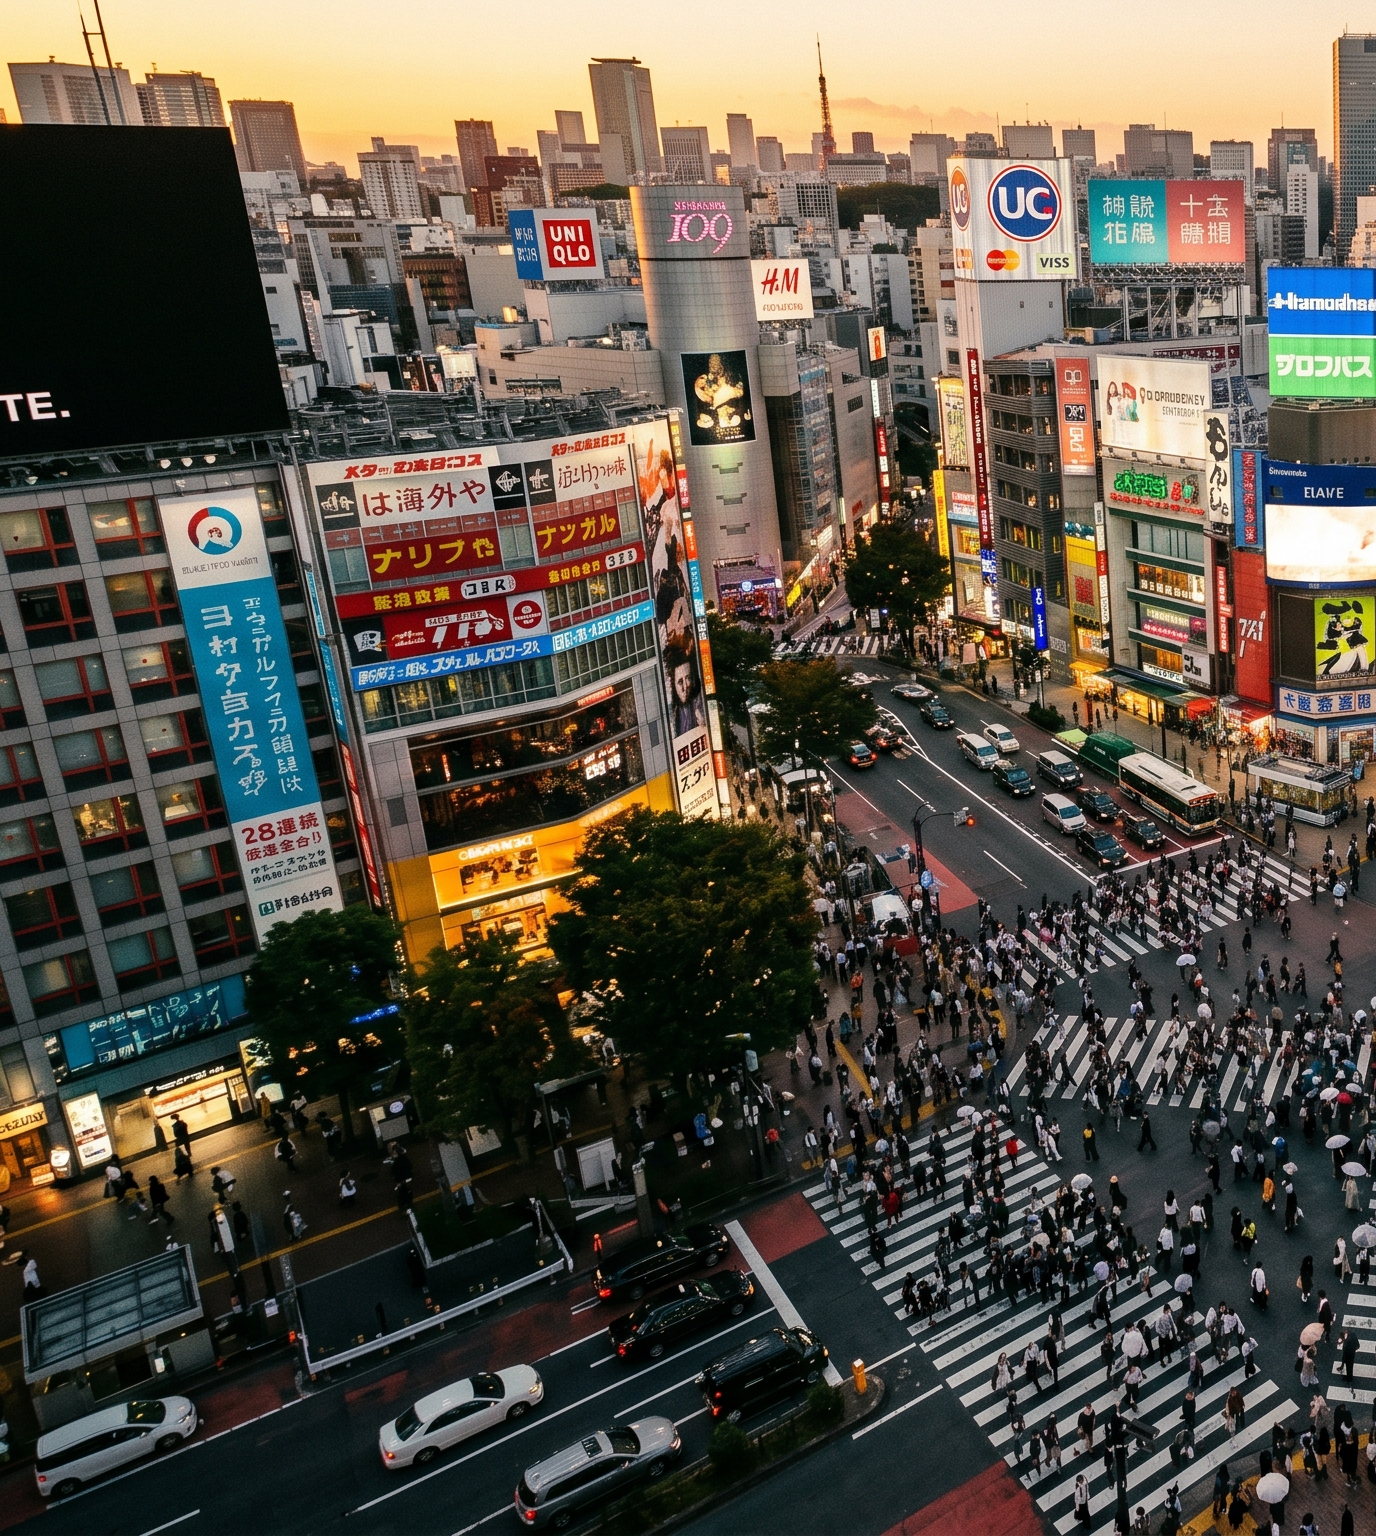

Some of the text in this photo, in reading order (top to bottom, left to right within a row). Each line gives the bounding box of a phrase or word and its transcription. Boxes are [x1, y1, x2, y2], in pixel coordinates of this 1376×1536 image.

[549, 226, 584, 242] UNI
[666, 213, 733, 254] 109
[553, 245, 591, 265] QLO
